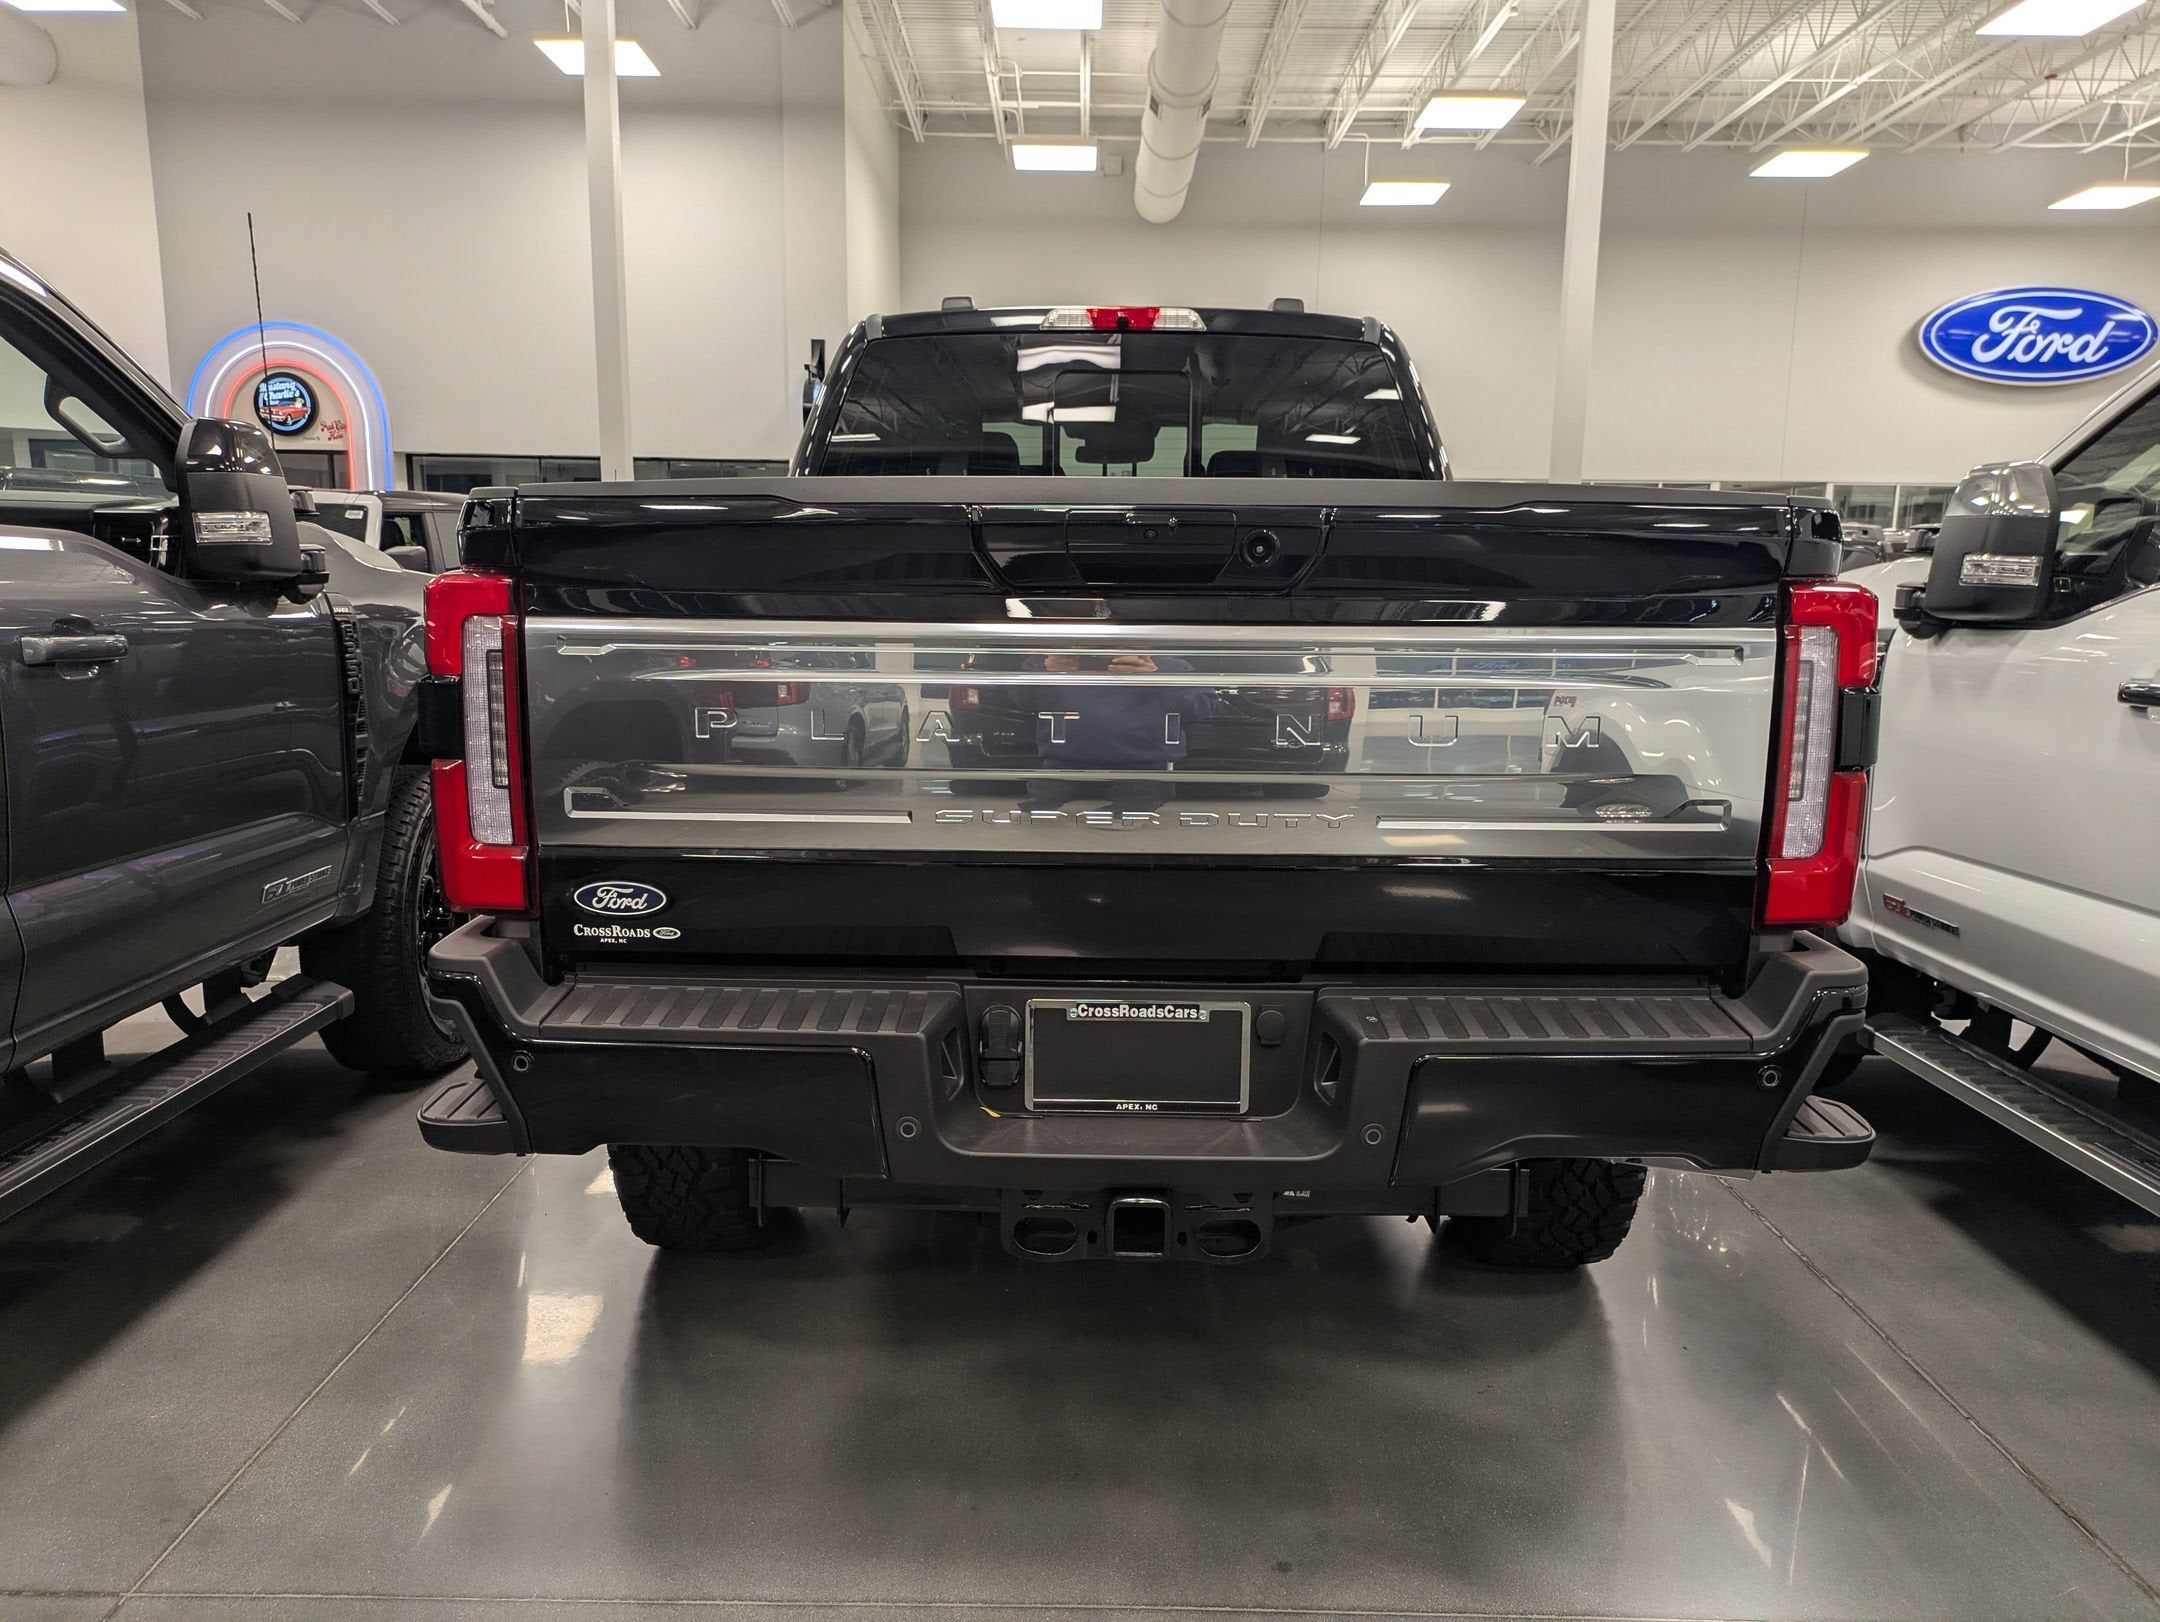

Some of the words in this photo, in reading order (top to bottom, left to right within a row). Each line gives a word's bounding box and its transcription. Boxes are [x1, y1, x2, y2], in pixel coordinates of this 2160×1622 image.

[1971, 305, 2116, 363] Ford
[694, 707, 1601, 748] PLATINUM
[935, 810, 1160, 826] SUPER
[1180, 812, 1354, 829] DUTY
[592, 886, 648, 909] Ford
[1077, 1003, 1198, 1019] CrossRoadsCars
